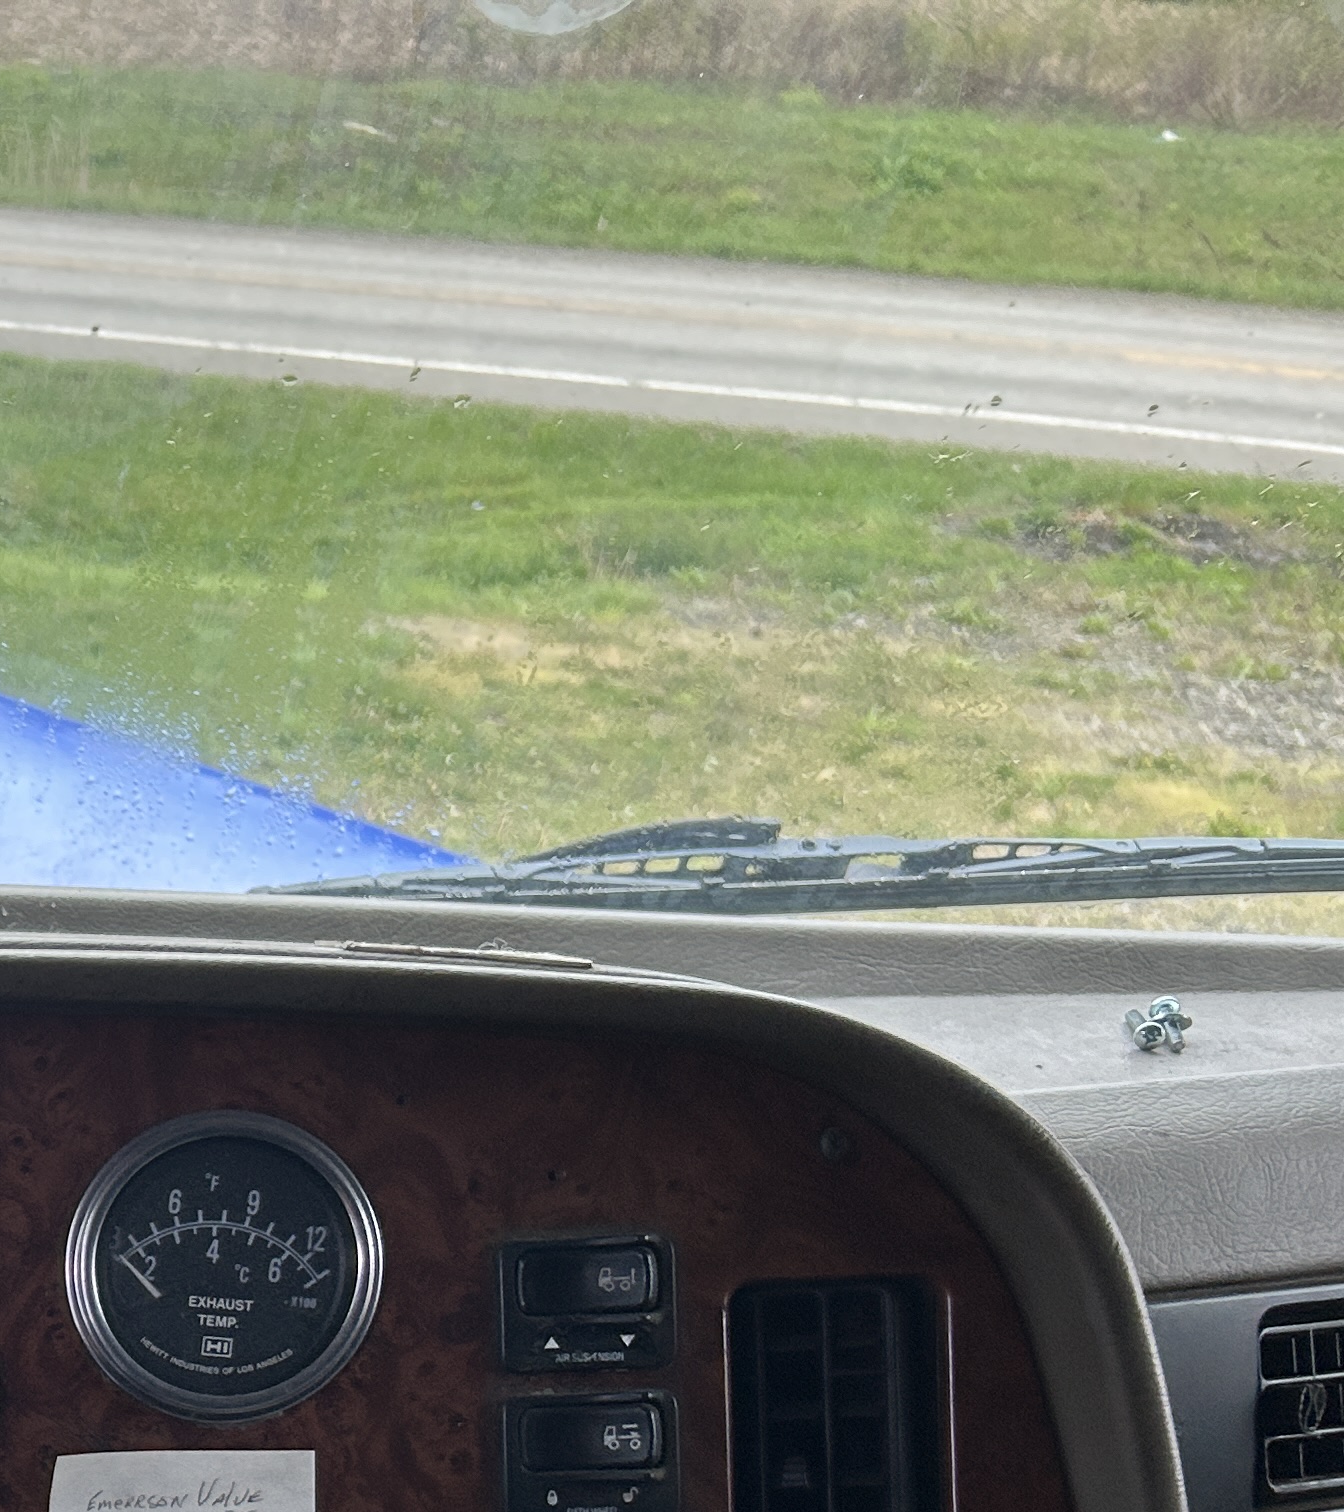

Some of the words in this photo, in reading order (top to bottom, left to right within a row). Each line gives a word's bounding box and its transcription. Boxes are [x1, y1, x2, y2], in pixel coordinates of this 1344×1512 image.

[168, 1188, 182, 1215] 6
[246, 1190, 260, 1215] 9
[206, 1239, 219, 1264] 4
[306, 1226, 328, 1252] 12
[144, 1256, 157, 1281] 2
[268, 1258, 282, 1283] 6
[188, 1295, 254, 1312] EXHAUST
[197, 1314, 239, 1329] TEMP.
